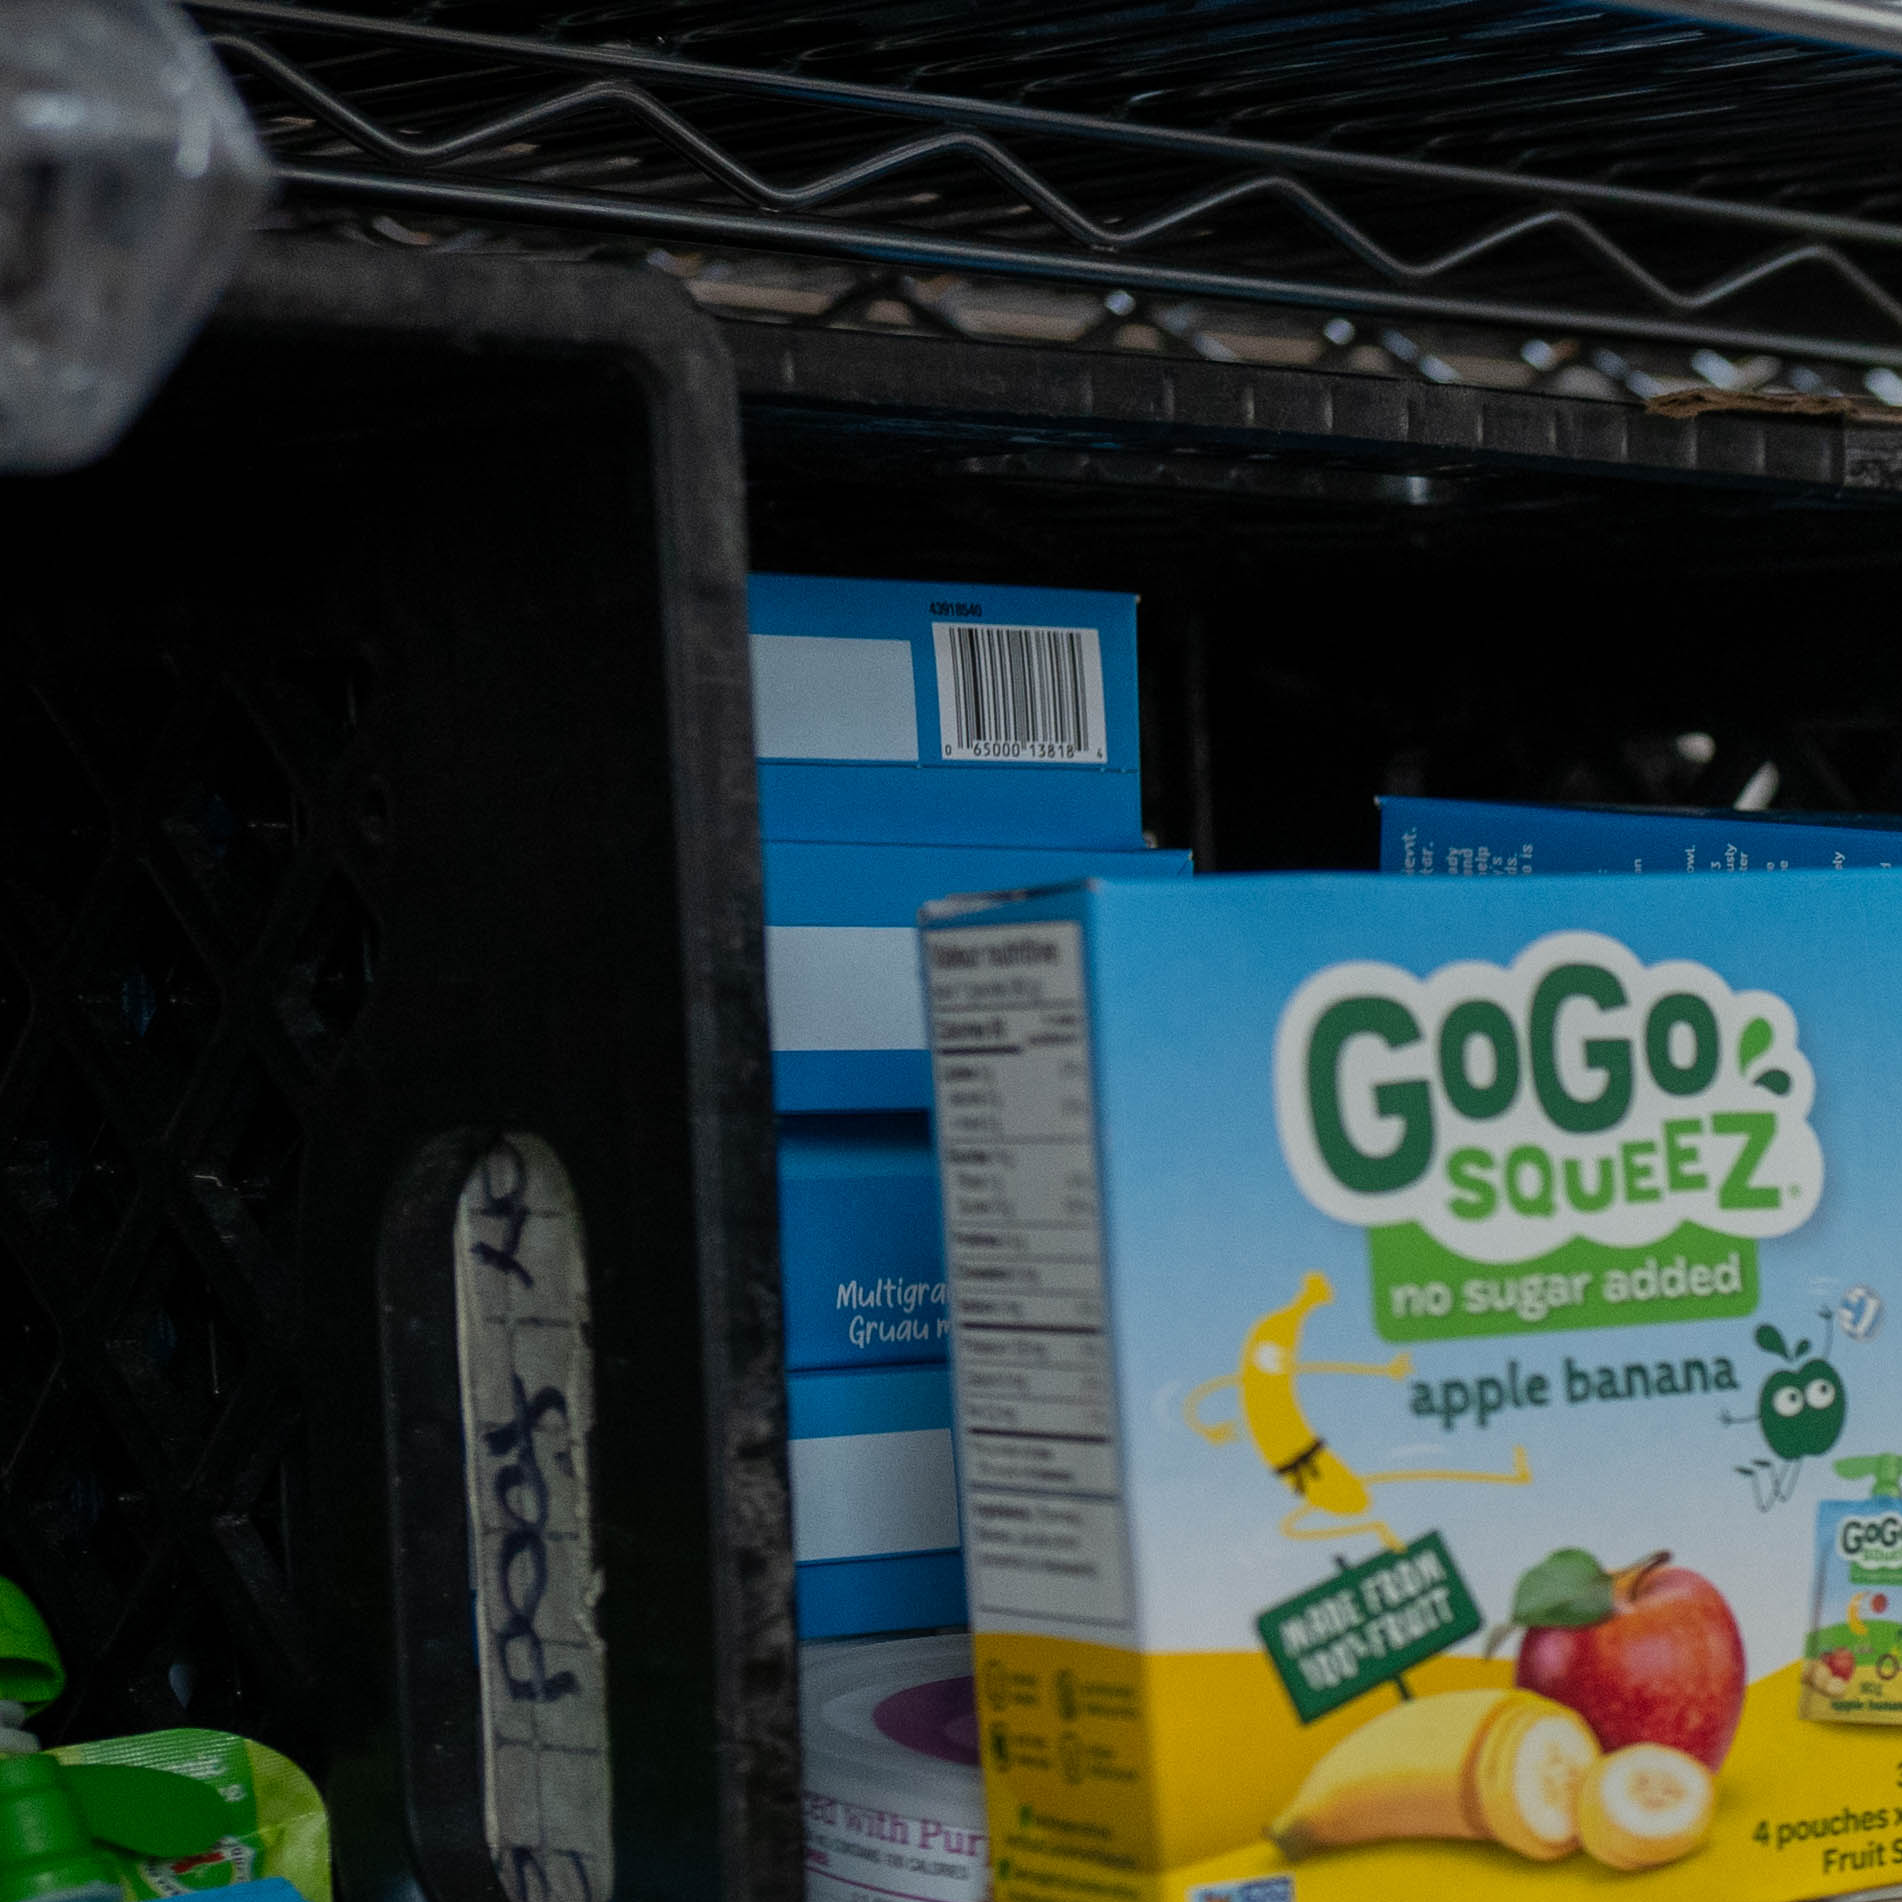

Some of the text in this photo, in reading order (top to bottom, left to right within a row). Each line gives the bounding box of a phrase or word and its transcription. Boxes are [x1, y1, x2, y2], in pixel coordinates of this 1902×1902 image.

[973, 742, 1075, 759] 65000 13818
[1306, 961, 1719, 1197] GoGo
[836, 1278, 948, 1314] Multigra
[1390, 1254, 1741, 1321] no sugar added
[849, 1315, 928, 1349] Gruau
[1409, 1356, 1740, 1431] apple banana
[1752, 1820, 1770, 1845] 4
[1776, 1806, 1889, 1851] pouches
[1822, 1842, 1885, 1876] Fruit
